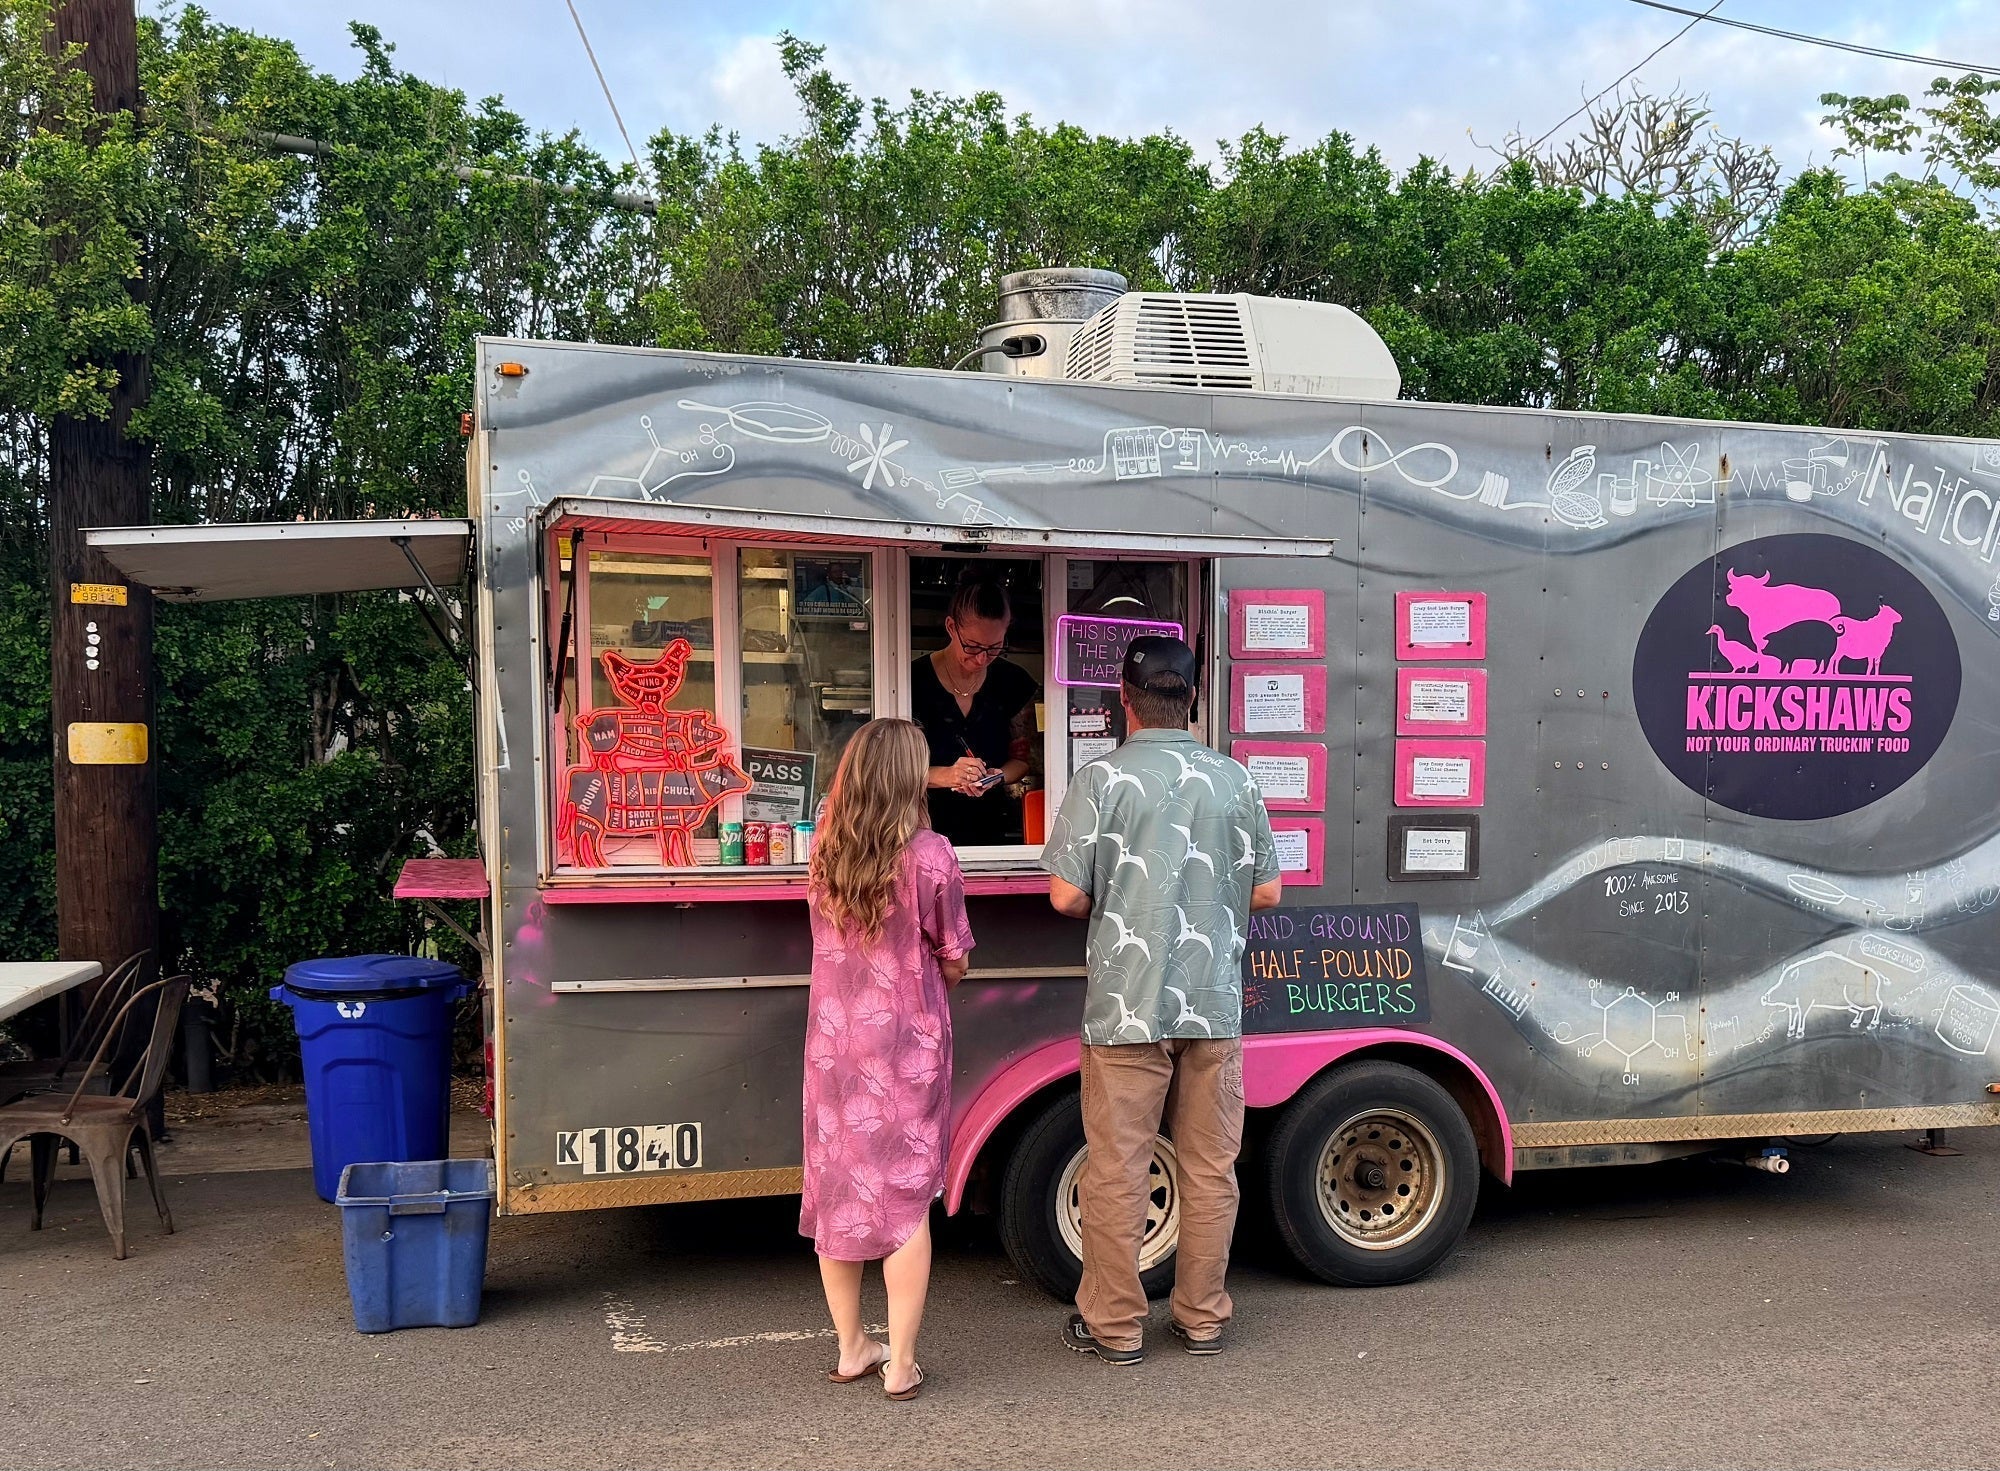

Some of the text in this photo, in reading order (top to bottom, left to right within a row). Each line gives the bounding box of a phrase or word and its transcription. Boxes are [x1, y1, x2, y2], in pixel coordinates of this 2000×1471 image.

[680, 449, 700, 464] OH
[506, 517, 527, 535] HO
[1103, 626, 1117, 642] IS
[1075, 642, 1108, 660] THE
[637, 677, 660, 687] WING
[1686, 685, 1912, 731] KICKSHAWS
[594, 730, 616, 742] HAM
[633, 726, 653, 735] LOIN
[692, 727, 714, 739] HEAD
[621, 745, 646, 757] BACON
[1686, 736, 1910, 752] NOT YOUR ORDINARY TRUCKIN' FOOD
[704, 771, 729, 786] HEAD
[749, 761, 803, 781] PASS
[579, 778, 602, 813] ROUND
[612, 776, 621, 802] SIRLOIN
[664, 785, 696, 796] CHUCK
[628, 809, 656, 819] SHORT
[629, 819, 655, 828] PLATE
[1604, 873, 1637, 897] 100%
[1655, 891, 1689, 915] 2013
[1862, 940, 1922, 970] @KICKSHAWS
[1588, 978, 1602, 990] OH
[1286, 982, 1416, 1014] BURGERS
[1666, 991, 1680, 1002] OH
[1952, 1028, 1972, 1045] FOOD
[1577, 1047, 1592, 1058] HO
[1664, 1047, 1679, 1058] OH
[1622, 1073, 1640, 1086] OH
